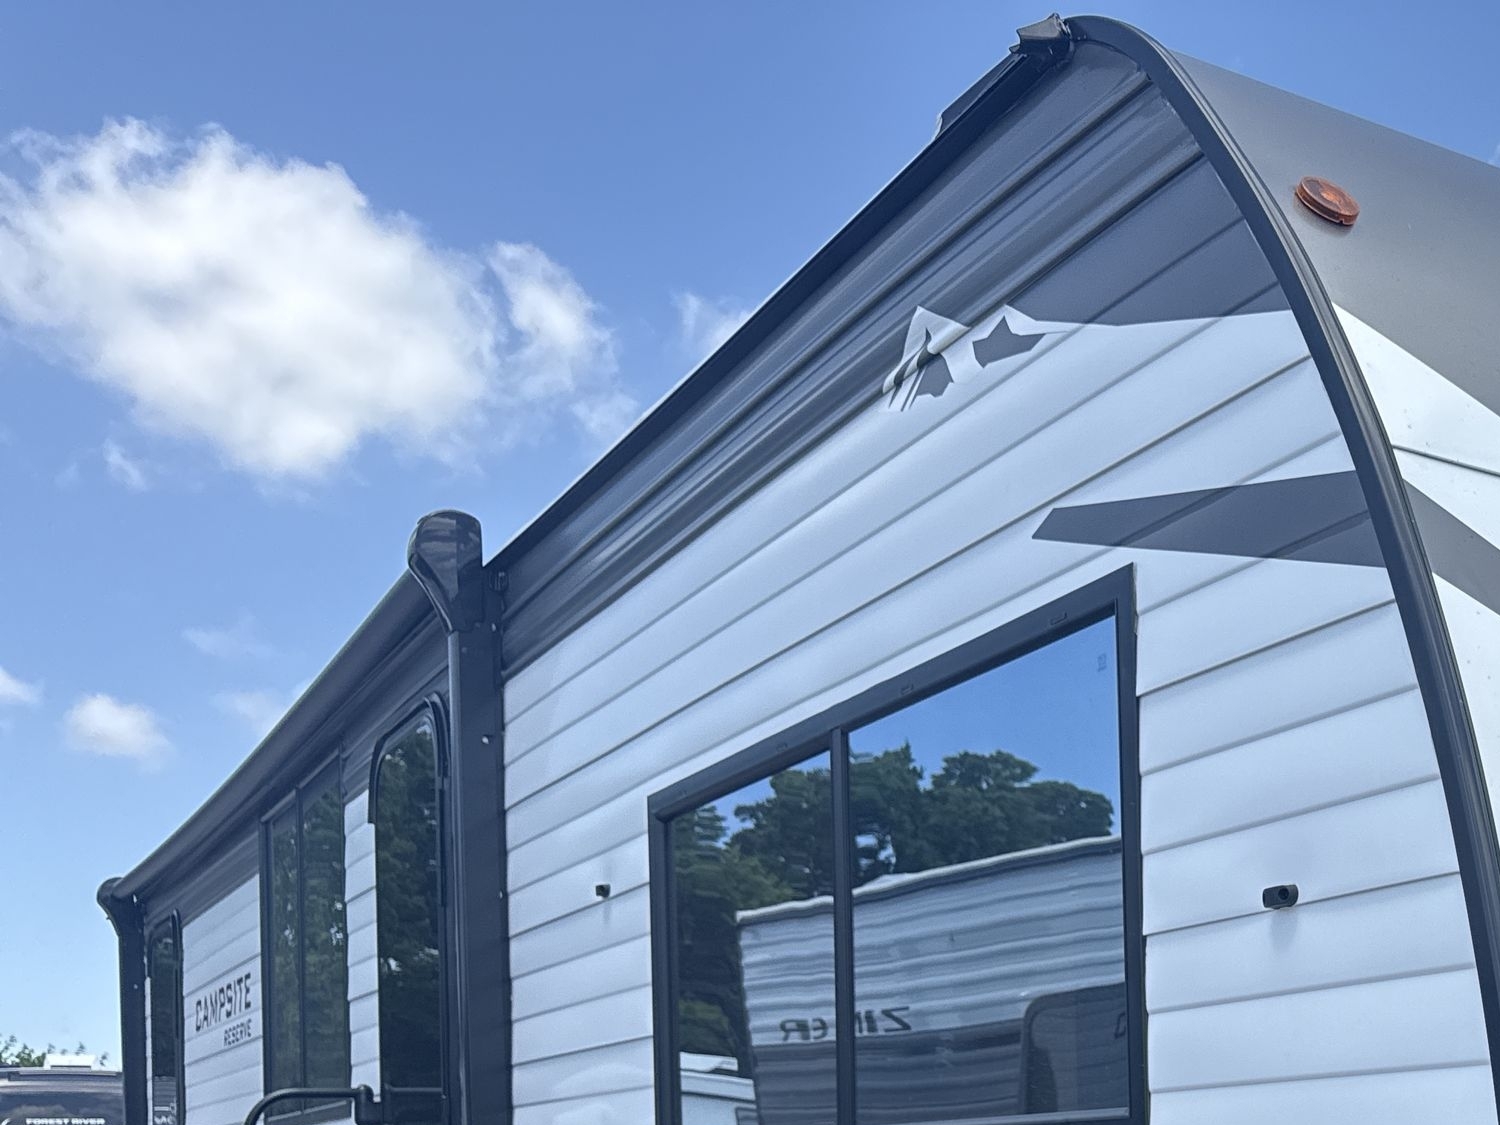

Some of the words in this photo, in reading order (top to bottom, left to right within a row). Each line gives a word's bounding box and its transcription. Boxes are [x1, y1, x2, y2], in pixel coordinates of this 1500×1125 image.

[196, 972, 251, 1032] CAMPSITE
[224, 1018, 251, 1047] RESERVE
[26, 1118, 69, 1125] FOREST
[71, 1118, 105, 1125] RIVER
